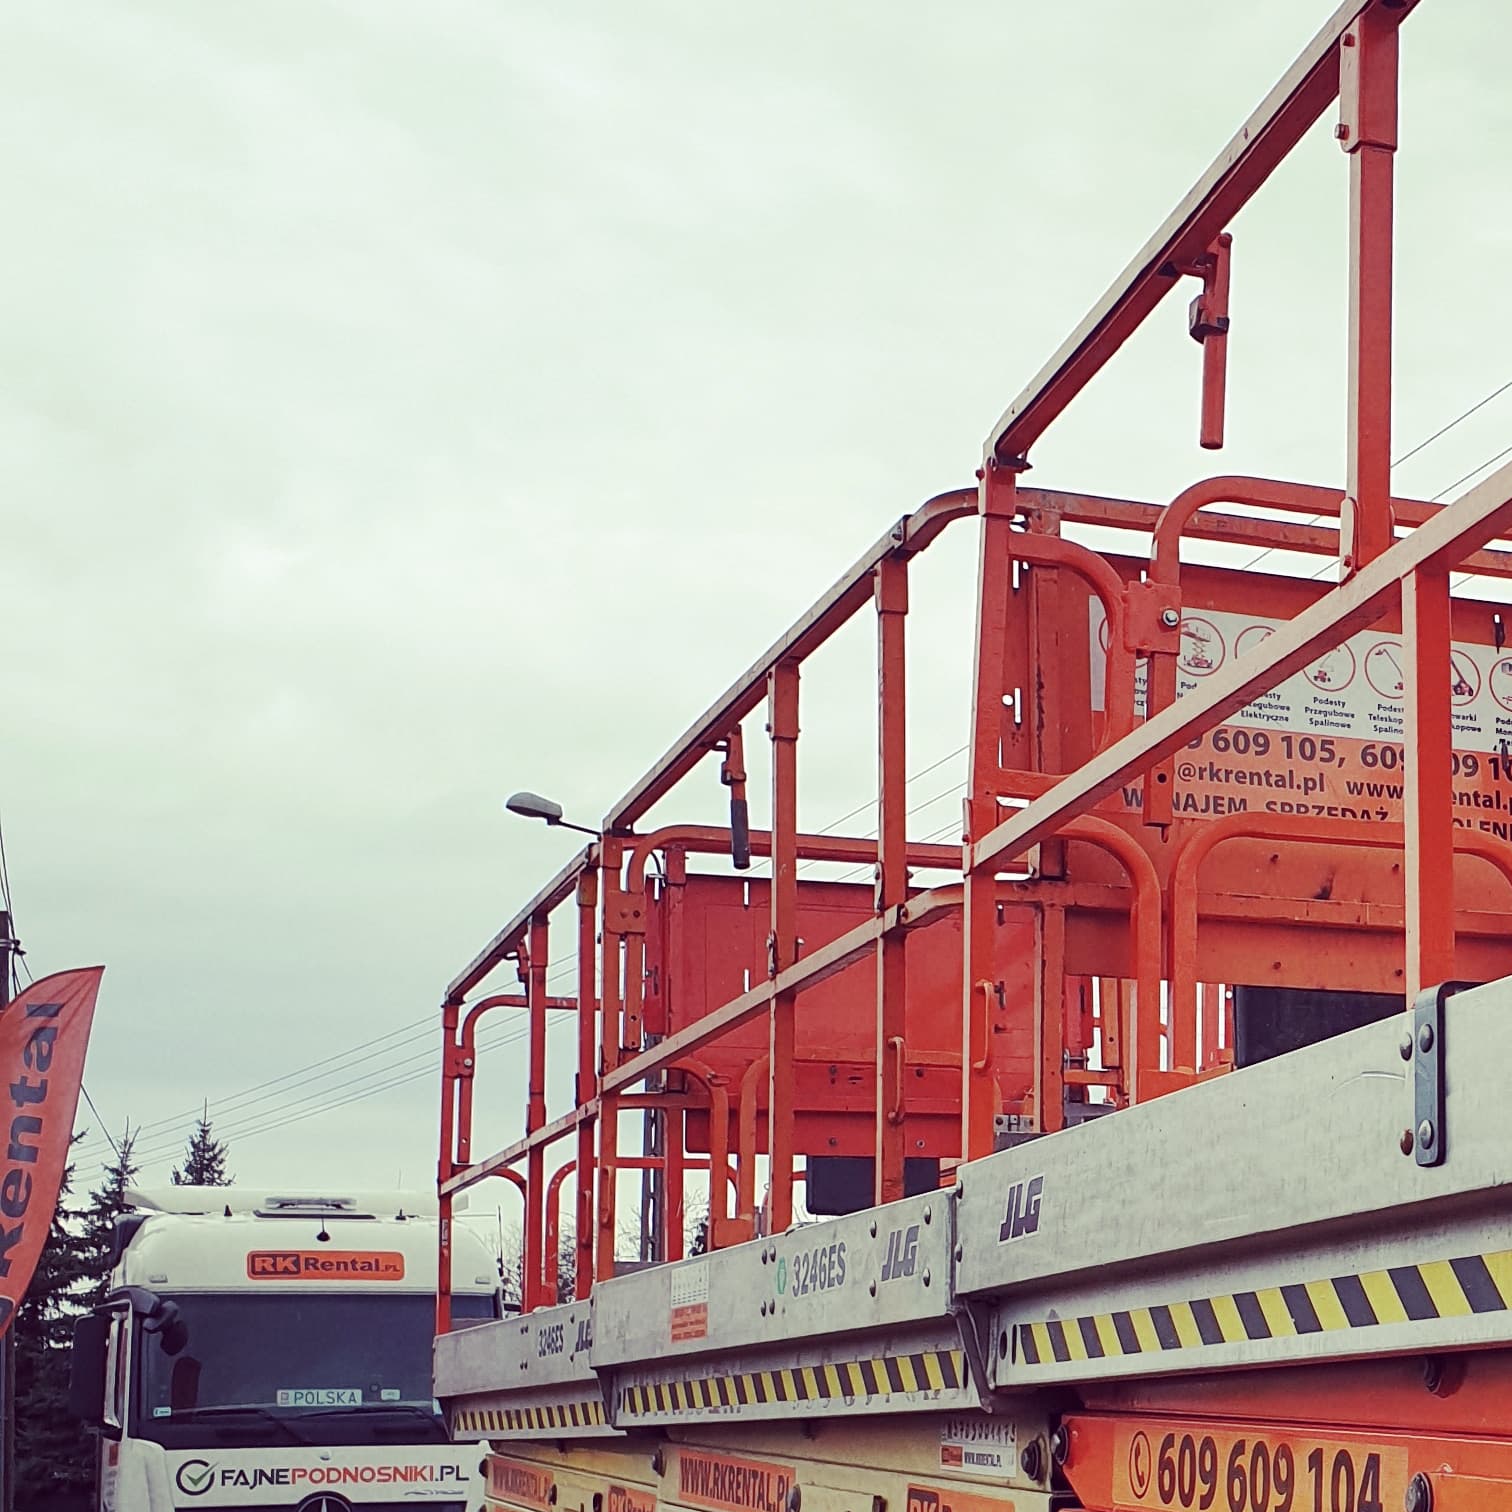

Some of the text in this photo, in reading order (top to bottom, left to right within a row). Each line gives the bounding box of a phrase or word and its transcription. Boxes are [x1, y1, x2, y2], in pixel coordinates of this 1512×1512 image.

[1305, 707, 1355, 719] Przegubowe
[1313, 697, 1346, 708] Podesty
[1309, 718, 1352, 729] Spalinowe
[1212, 728, 1271, 757] 609
[1361, 744, 1405, 771] 60
[999, 1175, 1044, 1242] JLG
[253, 1256, 299, 1273] RK
[792, 1225, 920, 1298] 3246ES JLG
[294, 1391, 357, 1405] POLSKA
[221, 1464, 470, 1490] FAJNEPODNOSNIKI.PL
[1158, 1432, 1217, 1511] 609
